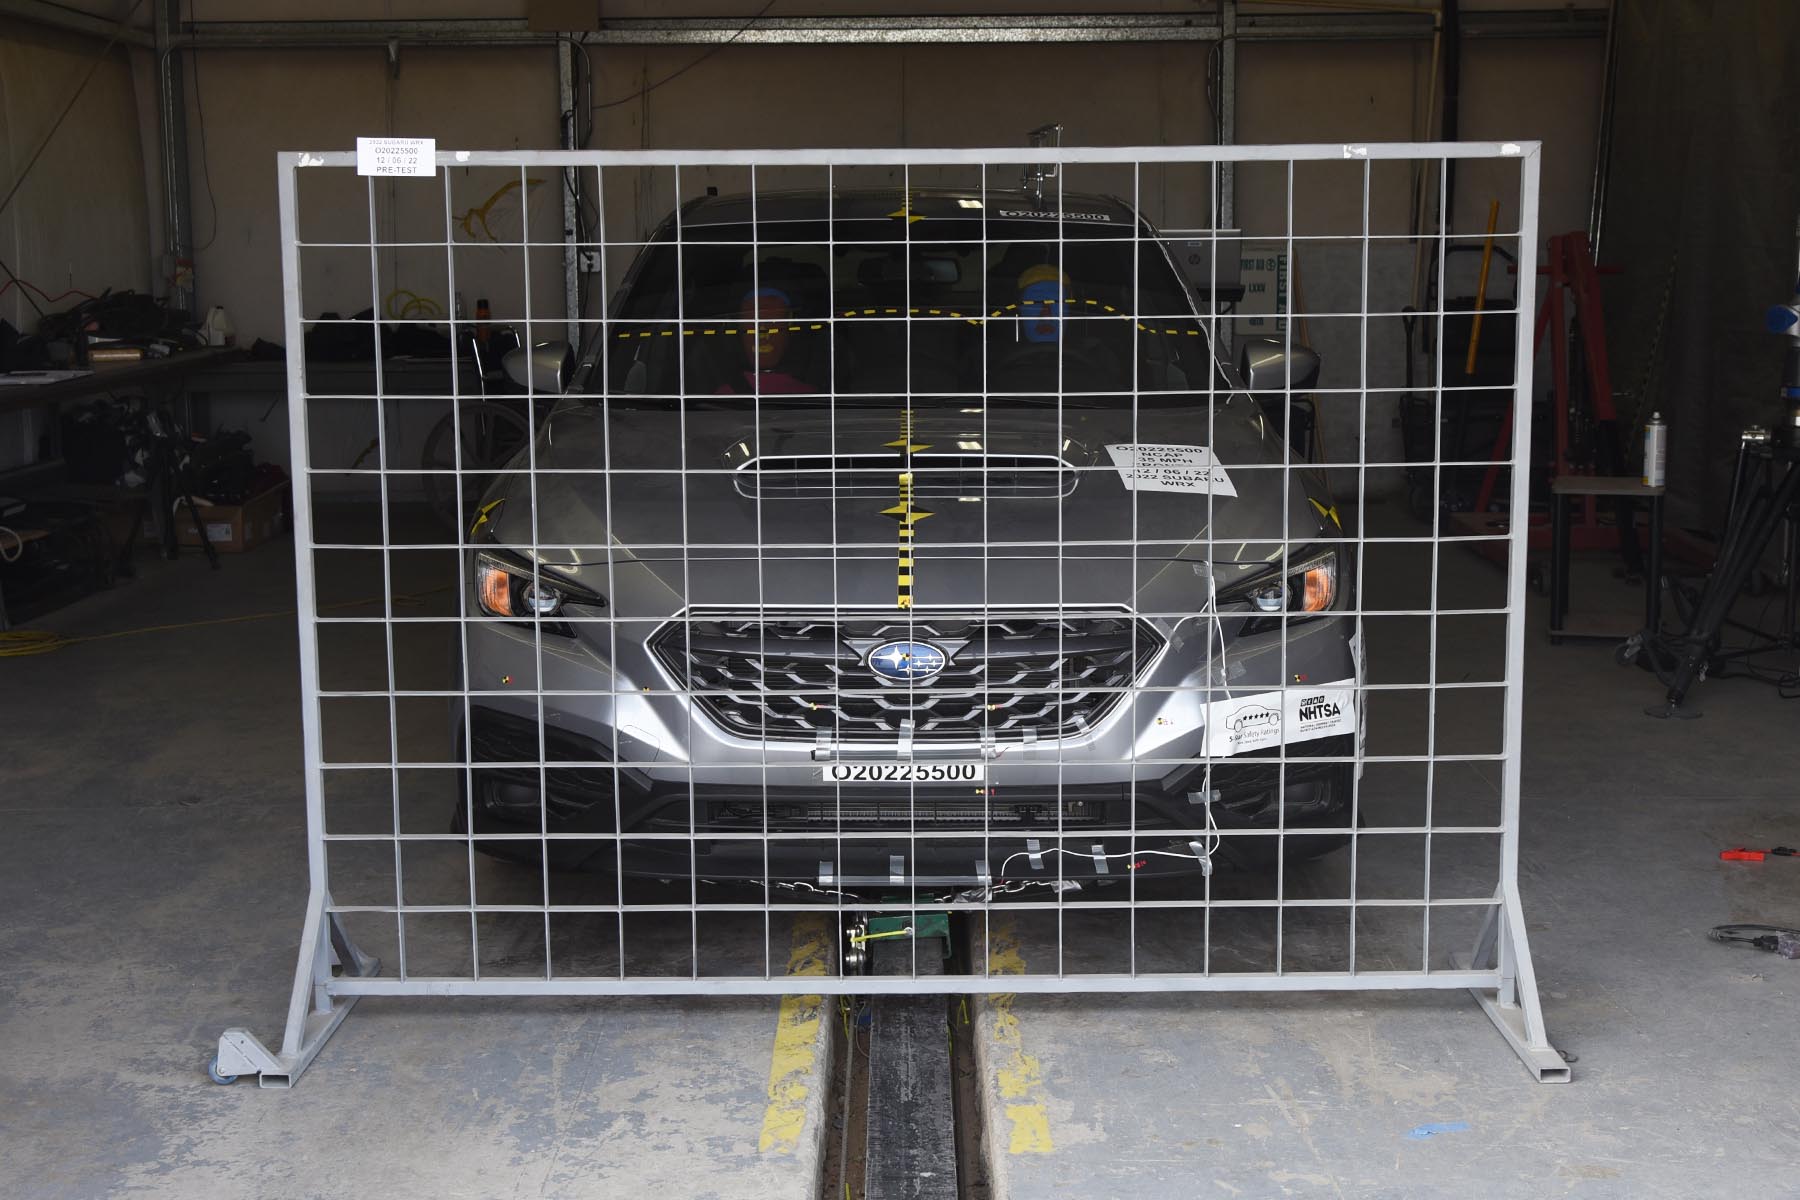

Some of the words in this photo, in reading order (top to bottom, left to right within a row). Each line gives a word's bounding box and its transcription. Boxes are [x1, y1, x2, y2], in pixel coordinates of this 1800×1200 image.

[376, 166, 417, 174] PRE-TEST
[1299, 702, 1341, 721] NHTSA
[832, 764, 976, 781] O20225500
